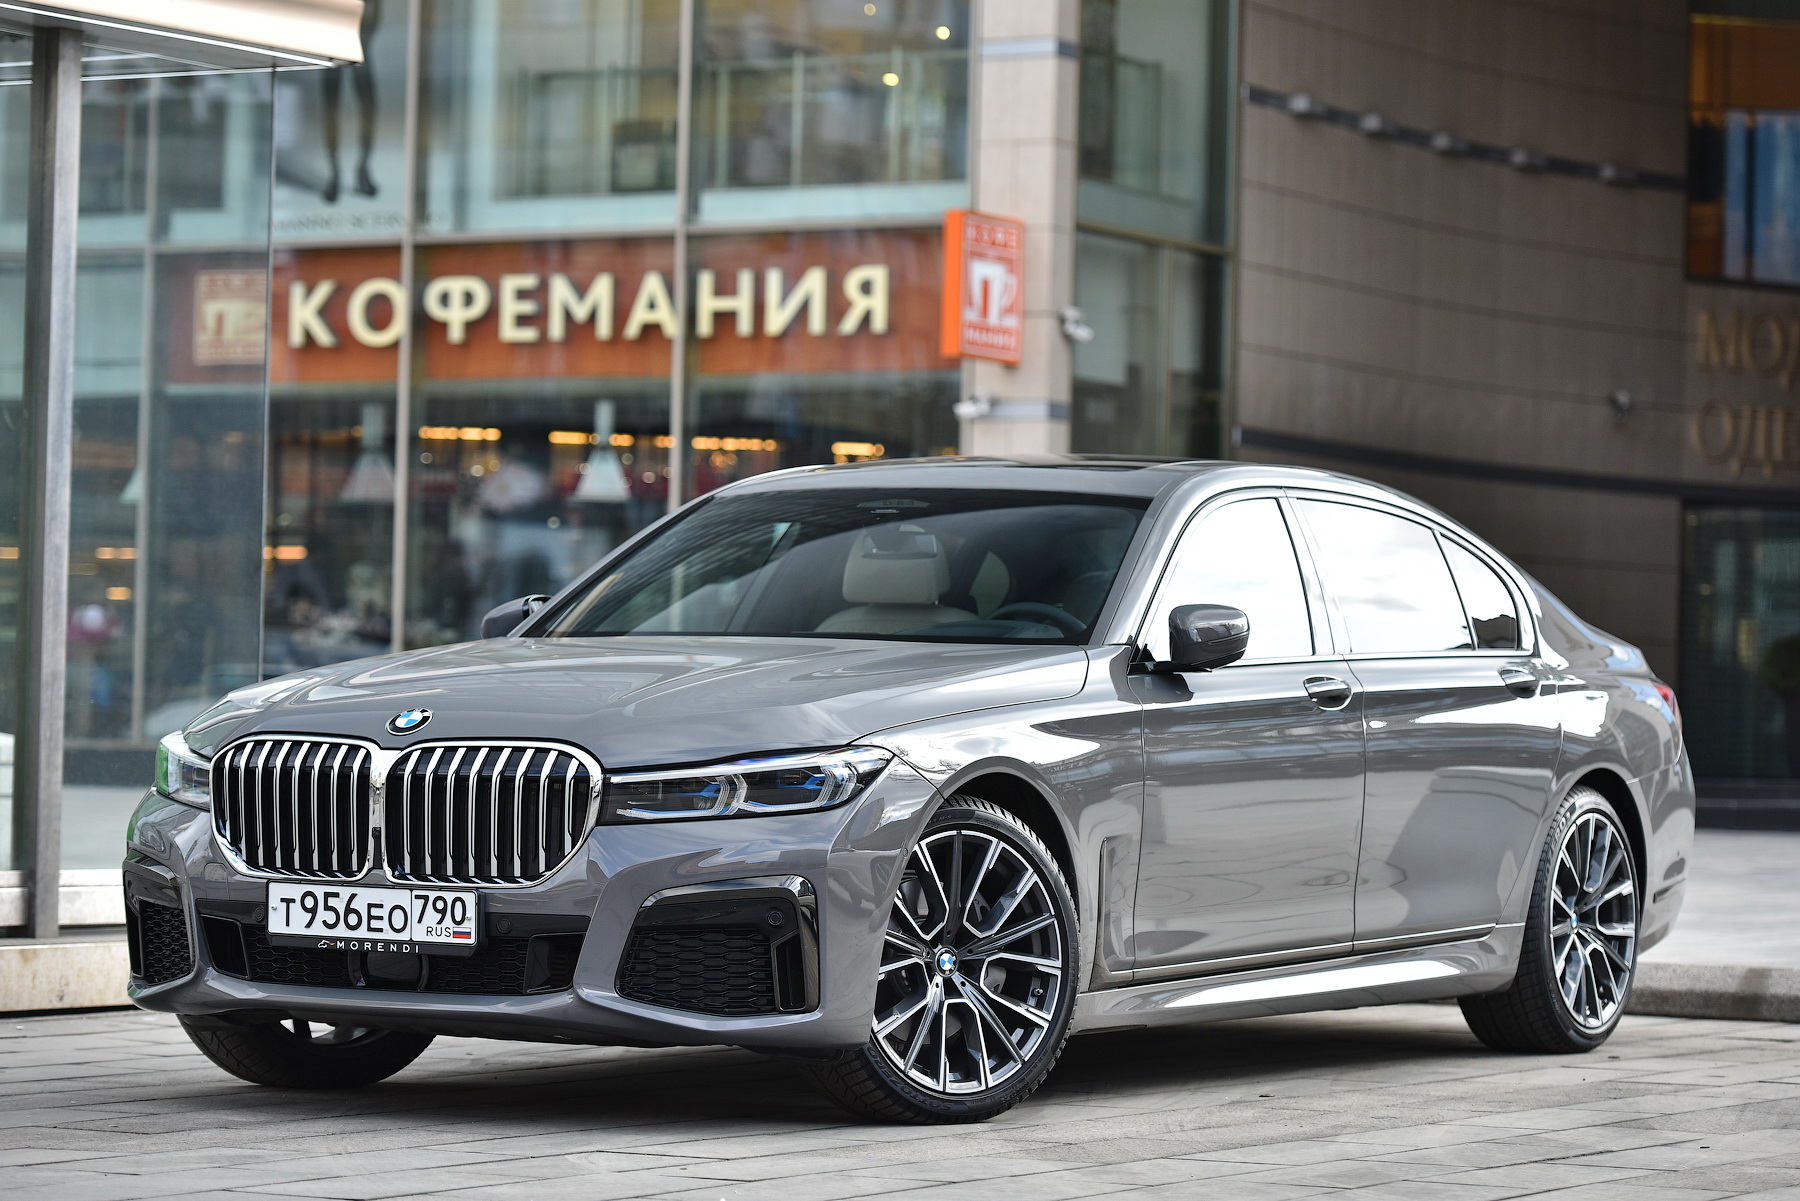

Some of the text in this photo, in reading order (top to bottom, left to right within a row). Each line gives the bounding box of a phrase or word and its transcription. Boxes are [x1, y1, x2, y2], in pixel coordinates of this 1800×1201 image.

[288, 264, 890, 348] КОФЕМАНИЯ
[414, 894, 467, 926] 790
[426, 926, 452, 937] RUS
[336, 941, 419, 953] MORENDI
